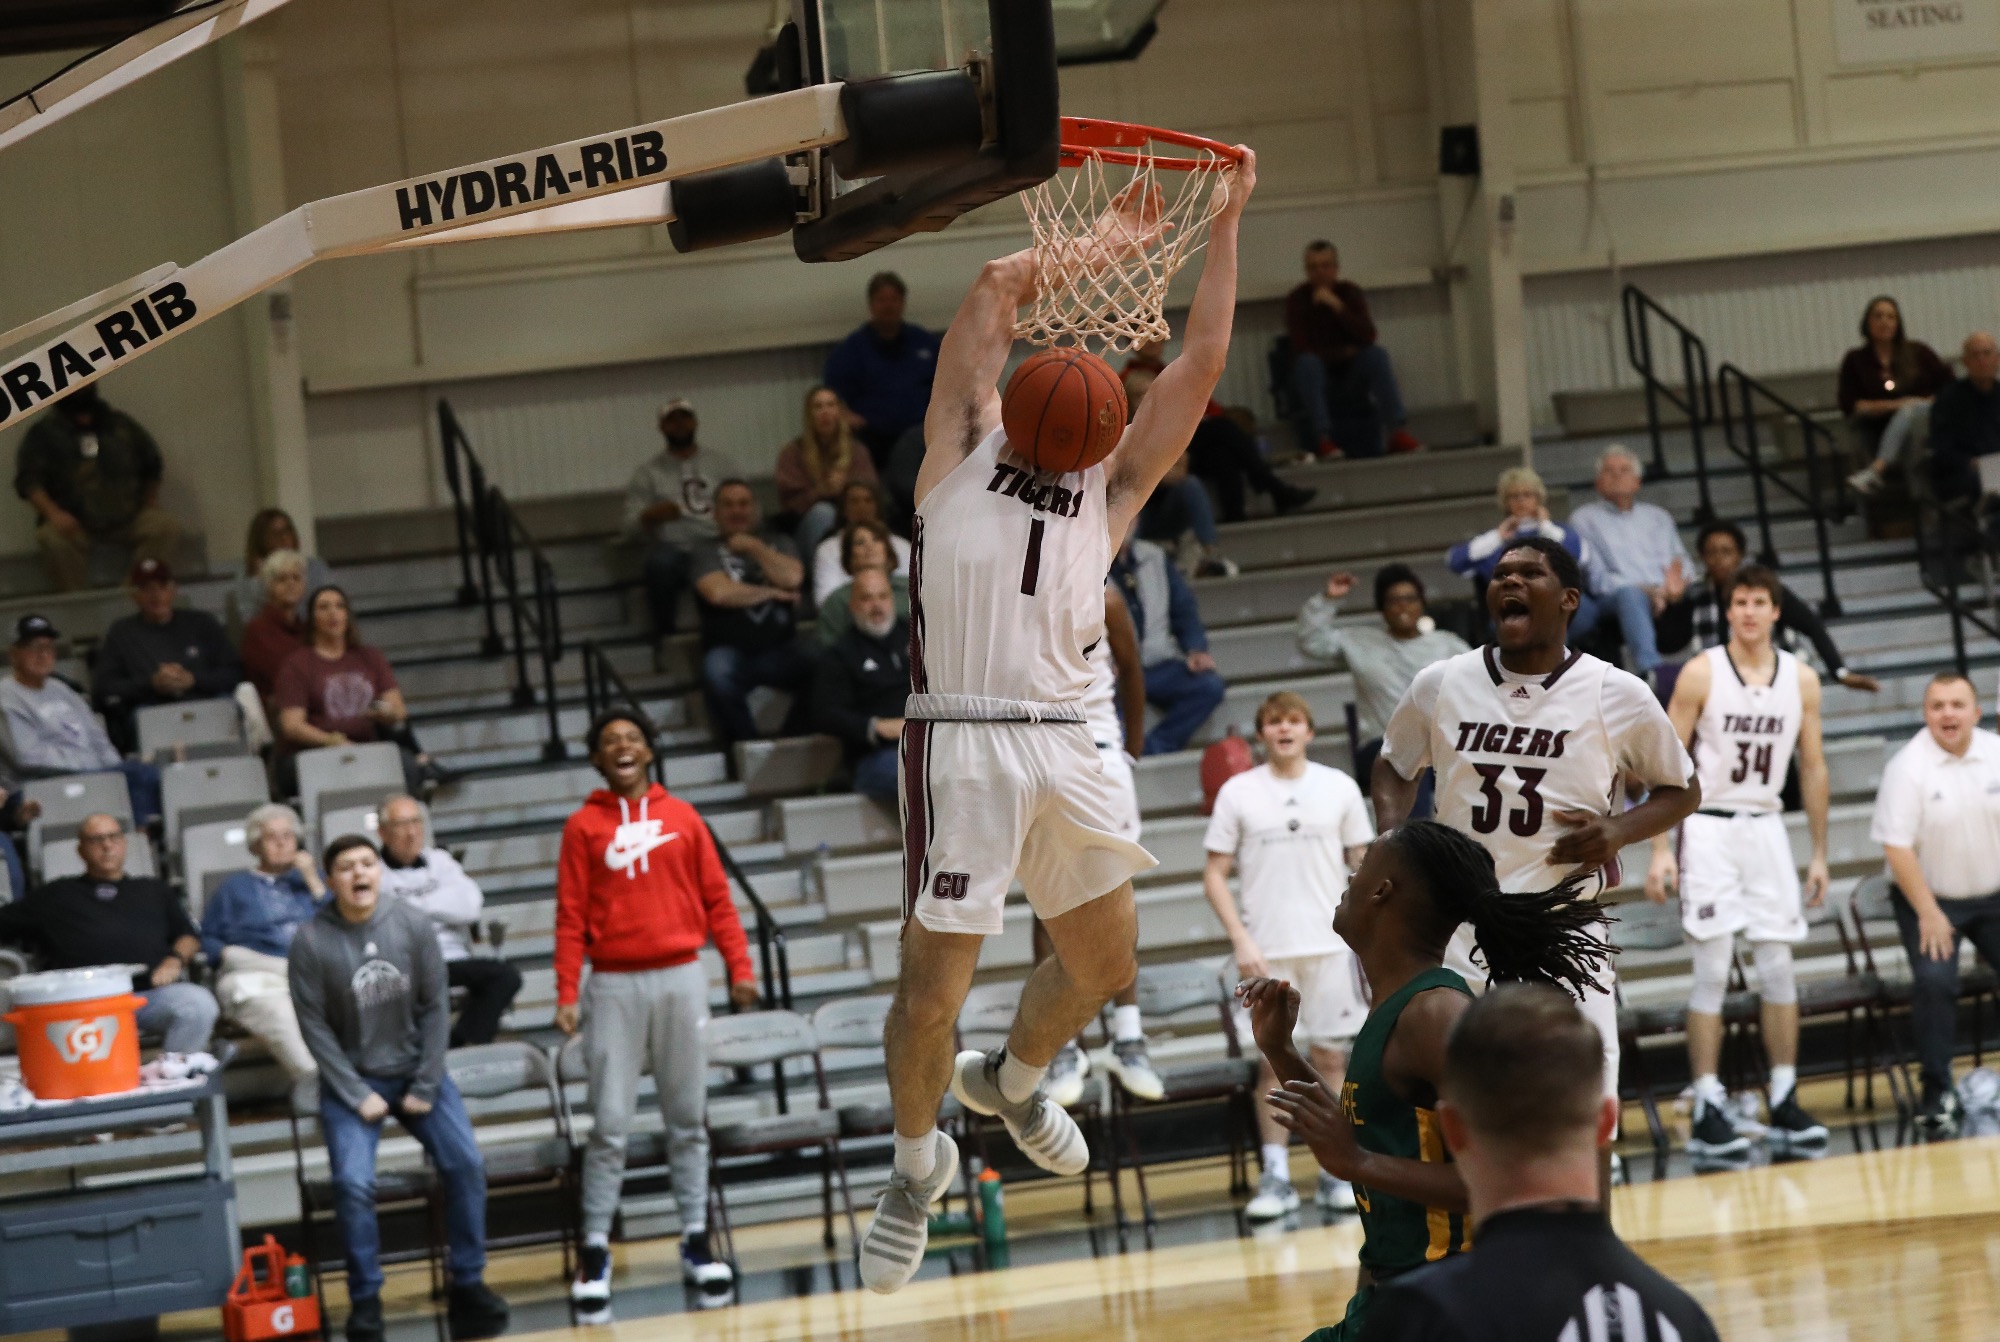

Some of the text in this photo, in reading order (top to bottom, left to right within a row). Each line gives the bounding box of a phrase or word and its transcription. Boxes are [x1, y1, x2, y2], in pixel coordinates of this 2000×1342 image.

[1866, 5, 1963, 28] SEATING
[395, 130, 668, 231] HYDRA-RIB
[1021, 518, 1045, 596] 1
[1455, 721, 1572, 759] TIGERS
[1723, 714, 1784, 734] TIGERS
[1730, 741, 1773, 785] 34
[1471, 762, 1548, 838] 33
[932, 870, 970, 901] CU
[271, 1304, 295, 1334] G
